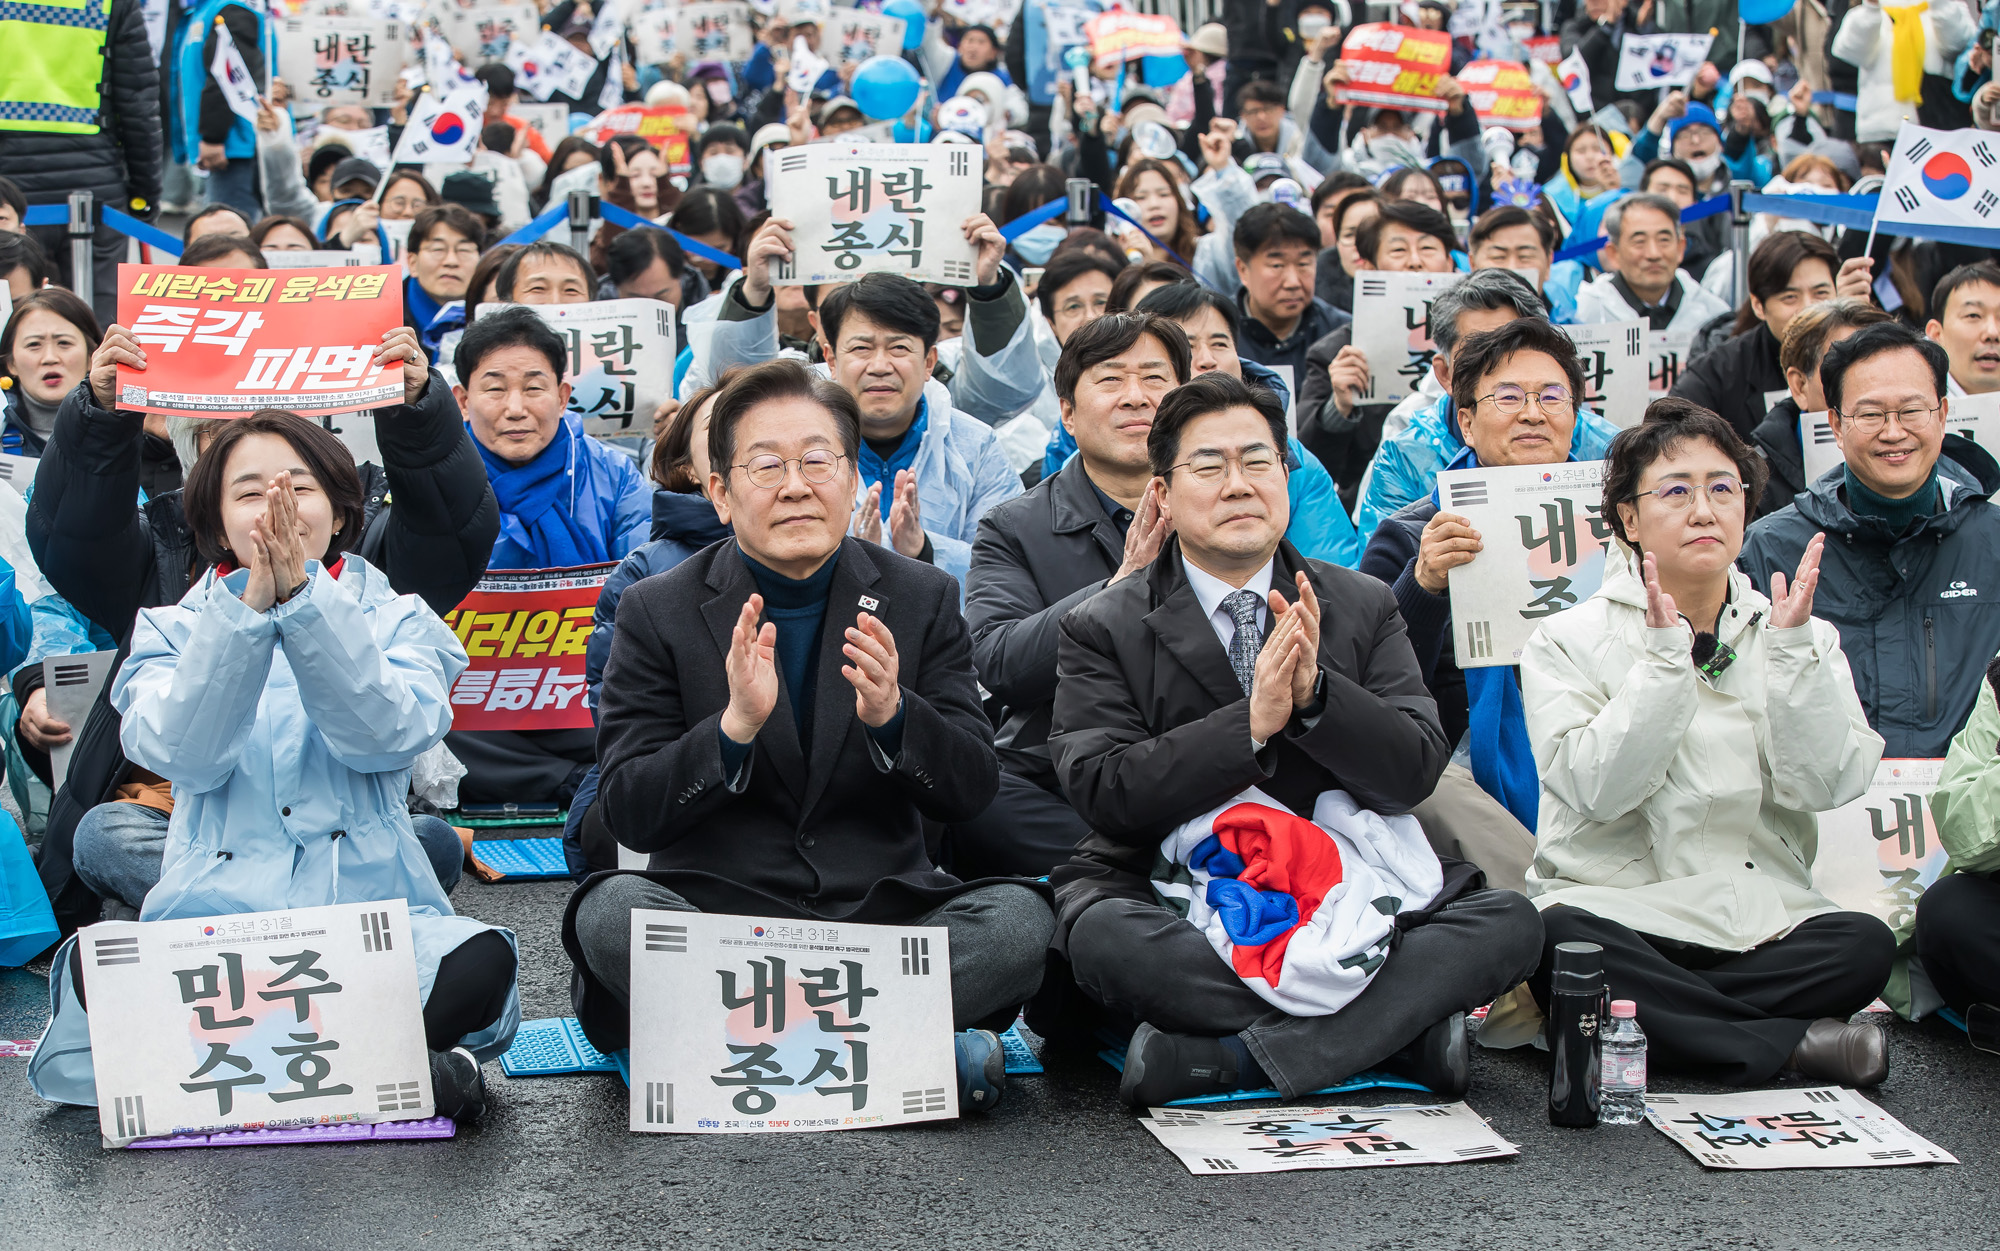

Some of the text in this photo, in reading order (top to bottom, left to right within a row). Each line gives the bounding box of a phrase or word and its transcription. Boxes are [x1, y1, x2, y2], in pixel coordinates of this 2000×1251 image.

[313, 33, 376, 65] 내란
[309, 68, 370, 98] 종식
[826, 166, 933, 214] 내란
[821, 218, 923, 270] 종식
[130, 272, 389, 304] 내란수괴 윤석열
[130, 304, 265, 356] 즉각
[235, 345, 386, 391] 파면!
[1940, 589, 1978, 599] EIDER
[450, 667, 590, 712] 석열을
[172, 949, 343, 1030] 민주
[715, 955, 879, 1033] 내란
[180, 1032, 354, 1116] 수호
[710, 1039, 869, 1115] 종식
[768, 1120, 790, 1128] 진보당
